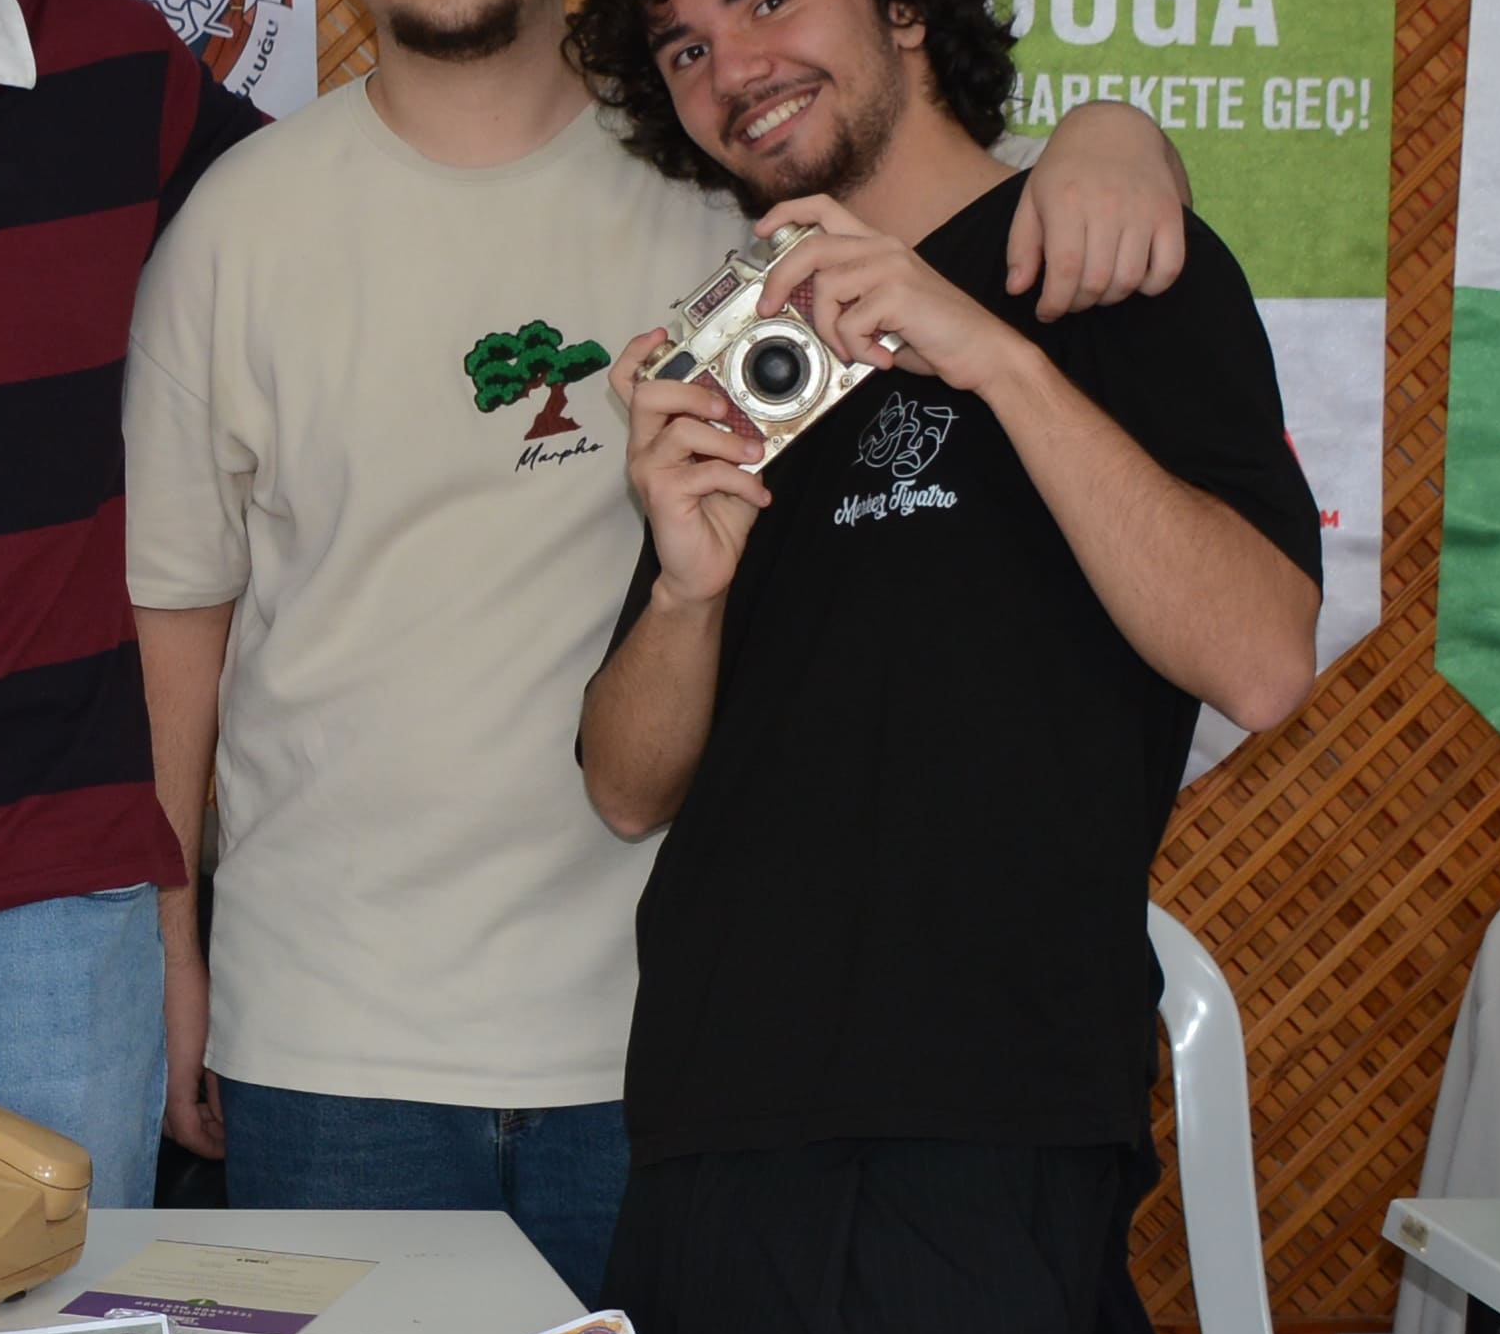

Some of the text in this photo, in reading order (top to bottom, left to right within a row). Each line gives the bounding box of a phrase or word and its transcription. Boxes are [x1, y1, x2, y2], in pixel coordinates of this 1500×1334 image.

[1263, 75, 1372, 138] GEÇ!
[833, 478, 958, 528] Merkez Tiyatro
